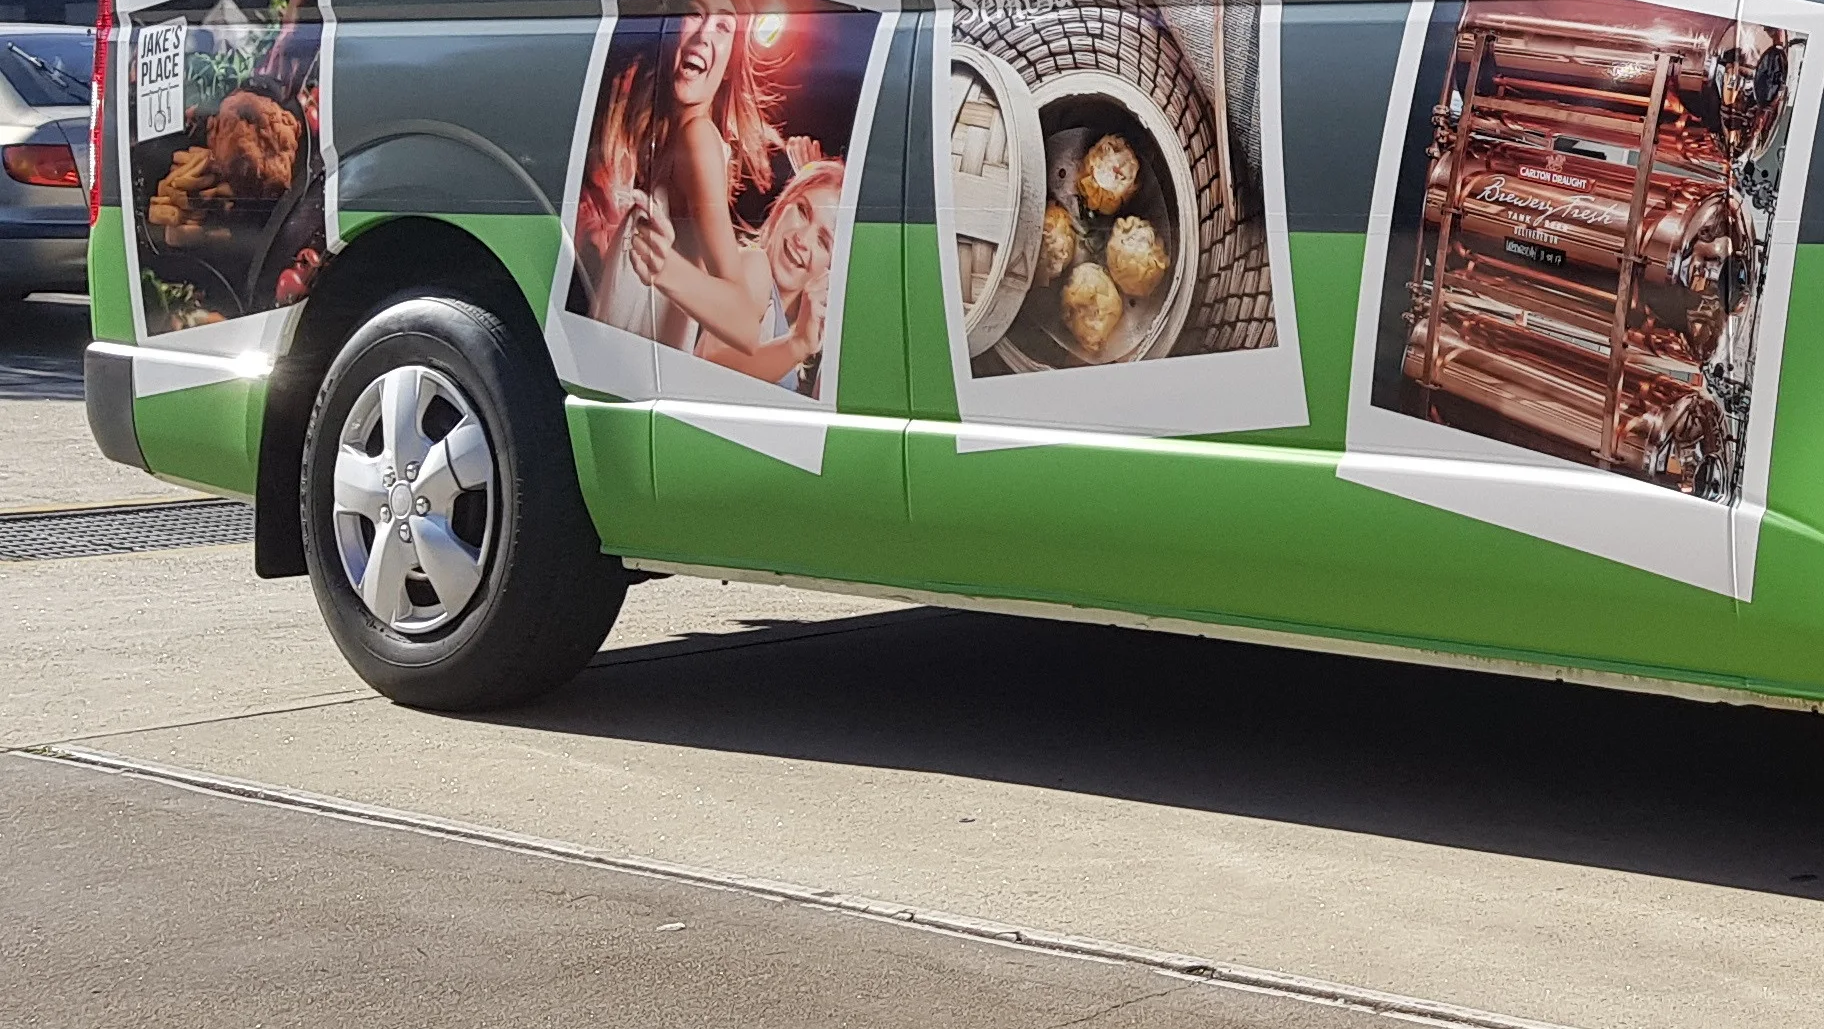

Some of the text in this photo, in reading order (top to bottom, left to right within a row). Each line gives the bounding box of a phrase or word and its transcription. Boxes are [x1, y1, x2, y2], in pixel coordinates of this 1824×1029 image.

[141, 24, 182, 59] JAKE'S
[141, 52, 180, 87] PLACE
[1519, 166, 1587, 190] CARLTON DRAUGHT
[1476, 177, 1630, 227] Brewery Fresh
[1508, 210, 1531, 224] TANK
